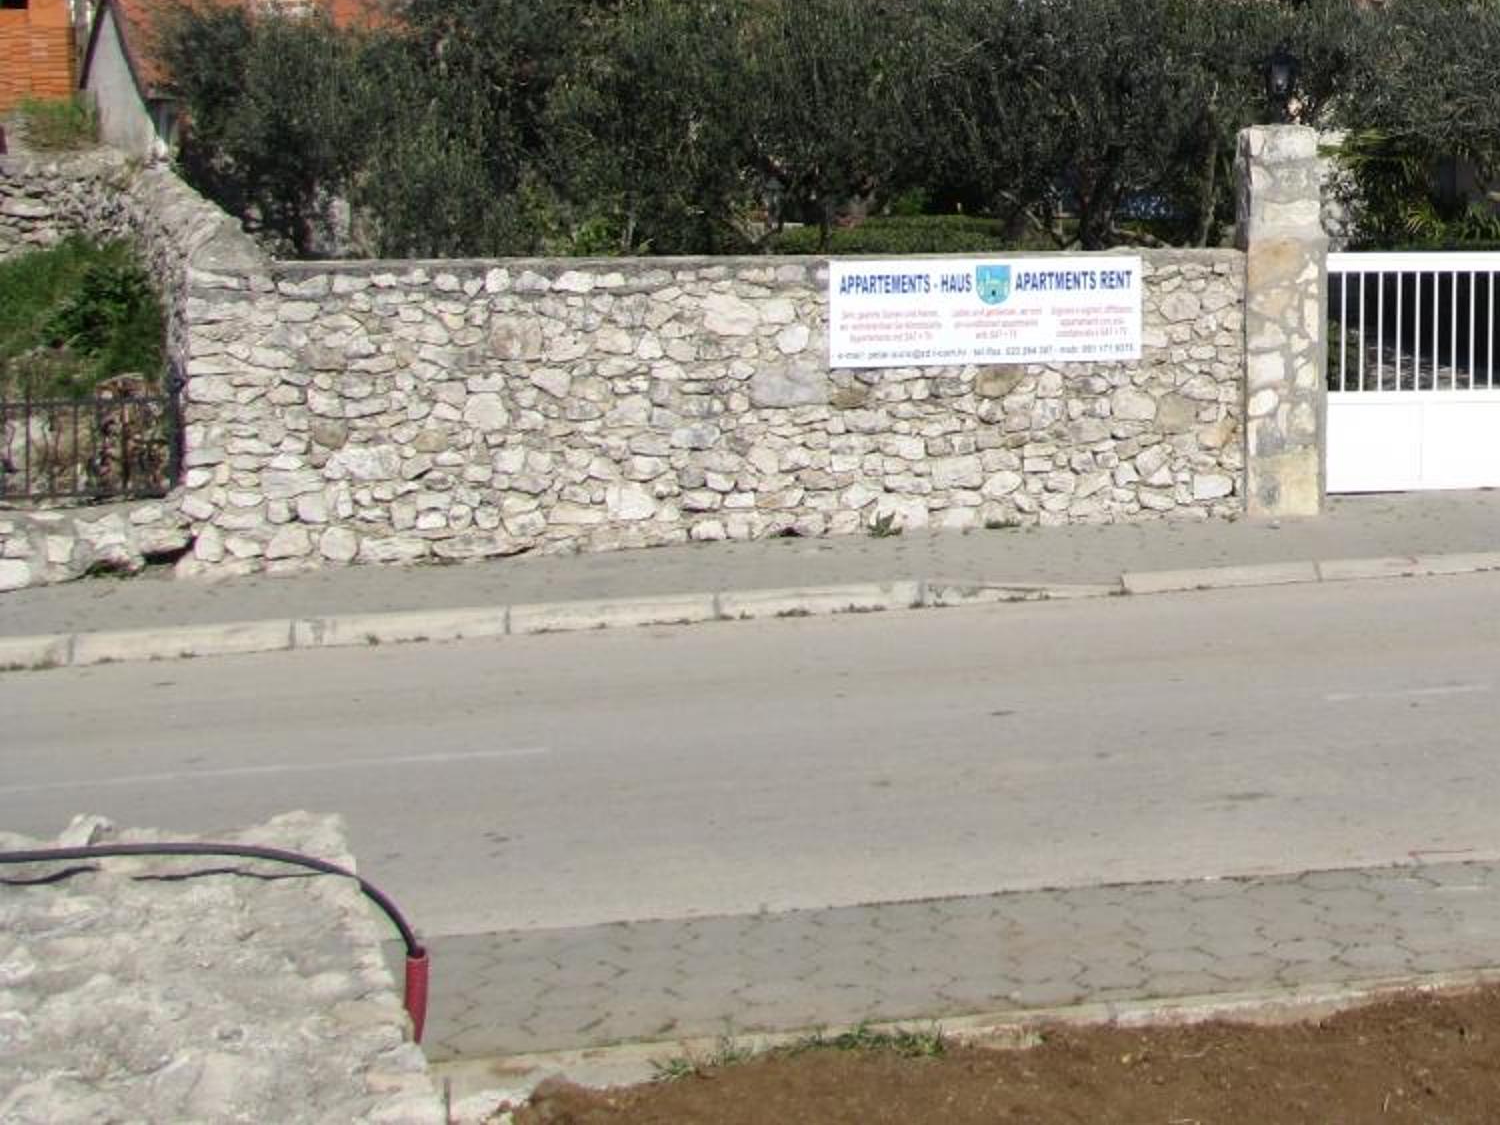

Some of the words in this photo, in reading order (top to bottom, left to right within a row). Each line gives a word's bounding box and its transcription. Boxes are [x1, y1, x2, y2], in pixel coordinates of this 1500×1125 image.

[840, 274, 931, 294] APPARTEMENTS
[941, 273, 972, 293] HAUS
[1015, 271, 1096, 290] APARTMENTS
[1100, 269, 1132, 289] RENT
